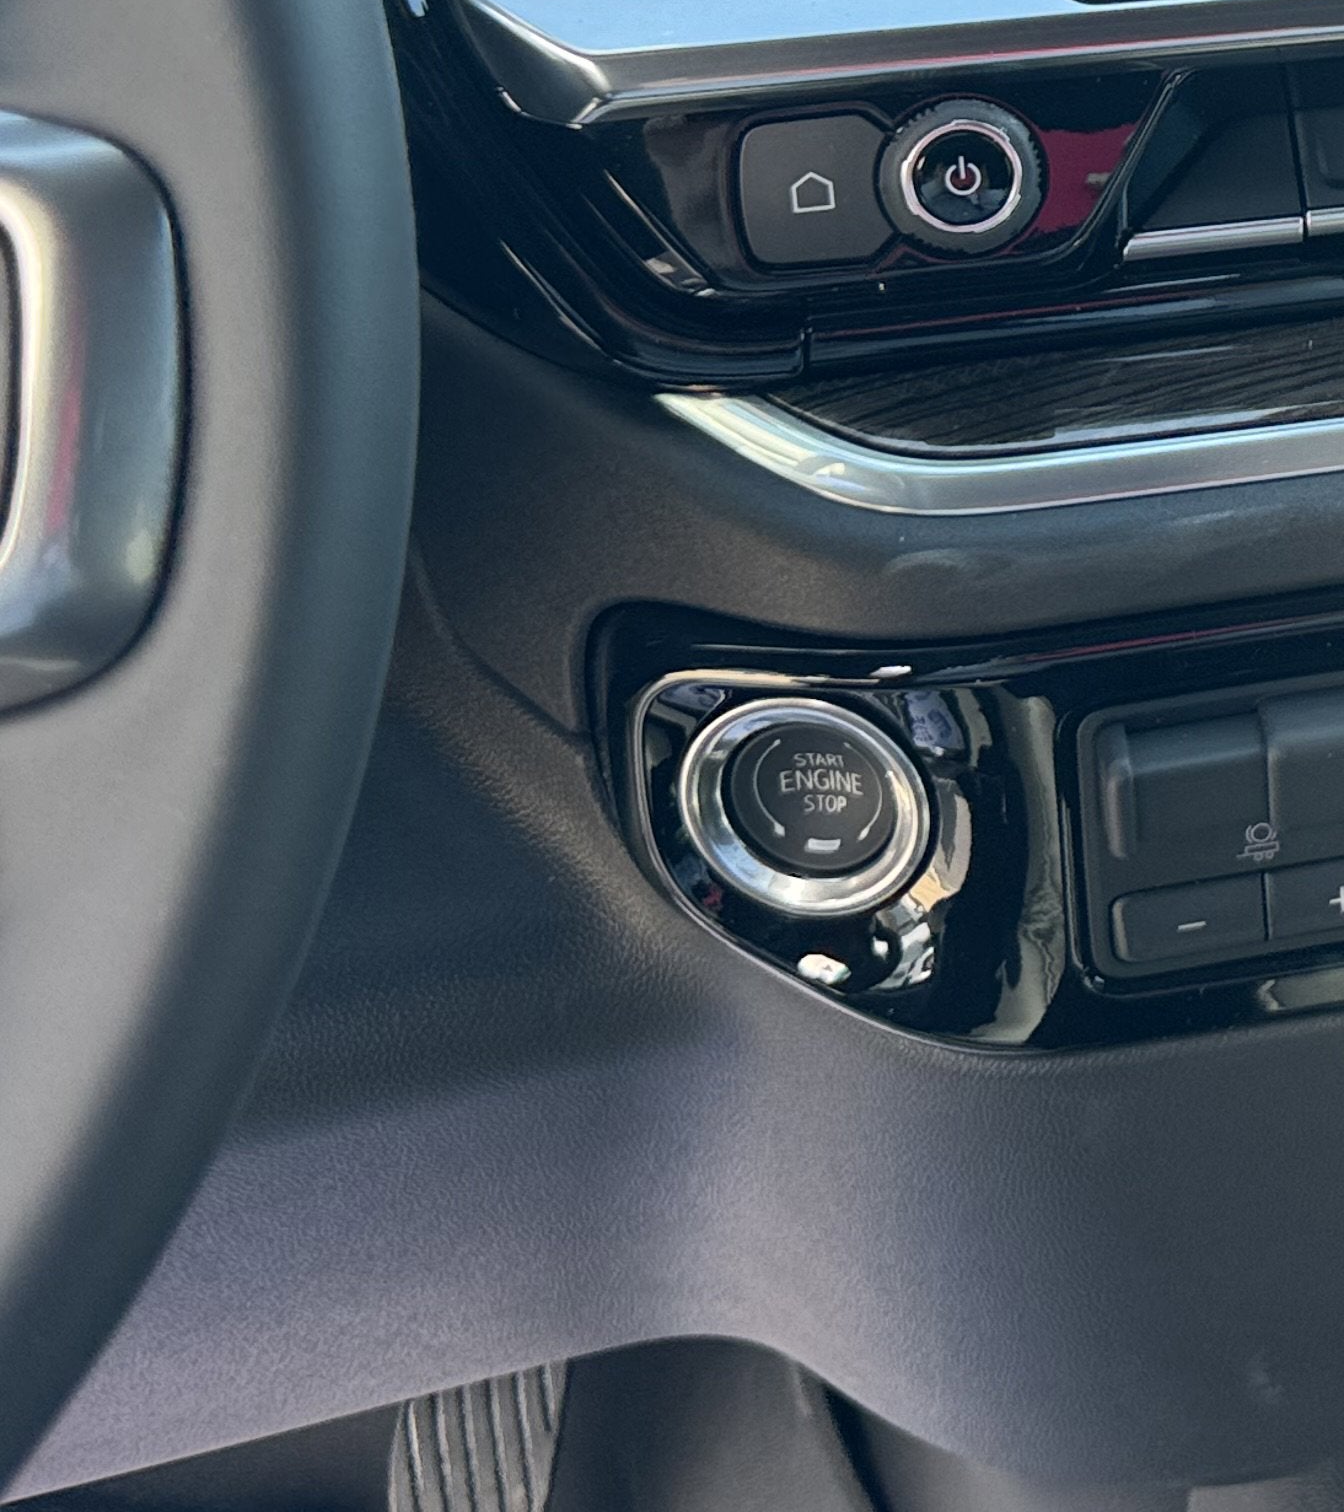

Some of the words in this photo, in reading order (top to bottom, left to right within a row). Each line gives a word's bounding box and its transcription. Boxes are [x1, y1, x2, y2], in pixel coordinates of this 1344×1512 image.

[793, 753, 844, 768] START
[780, 768, 864, 795] ENGINE
[804, 794, 847, 813] STOP
